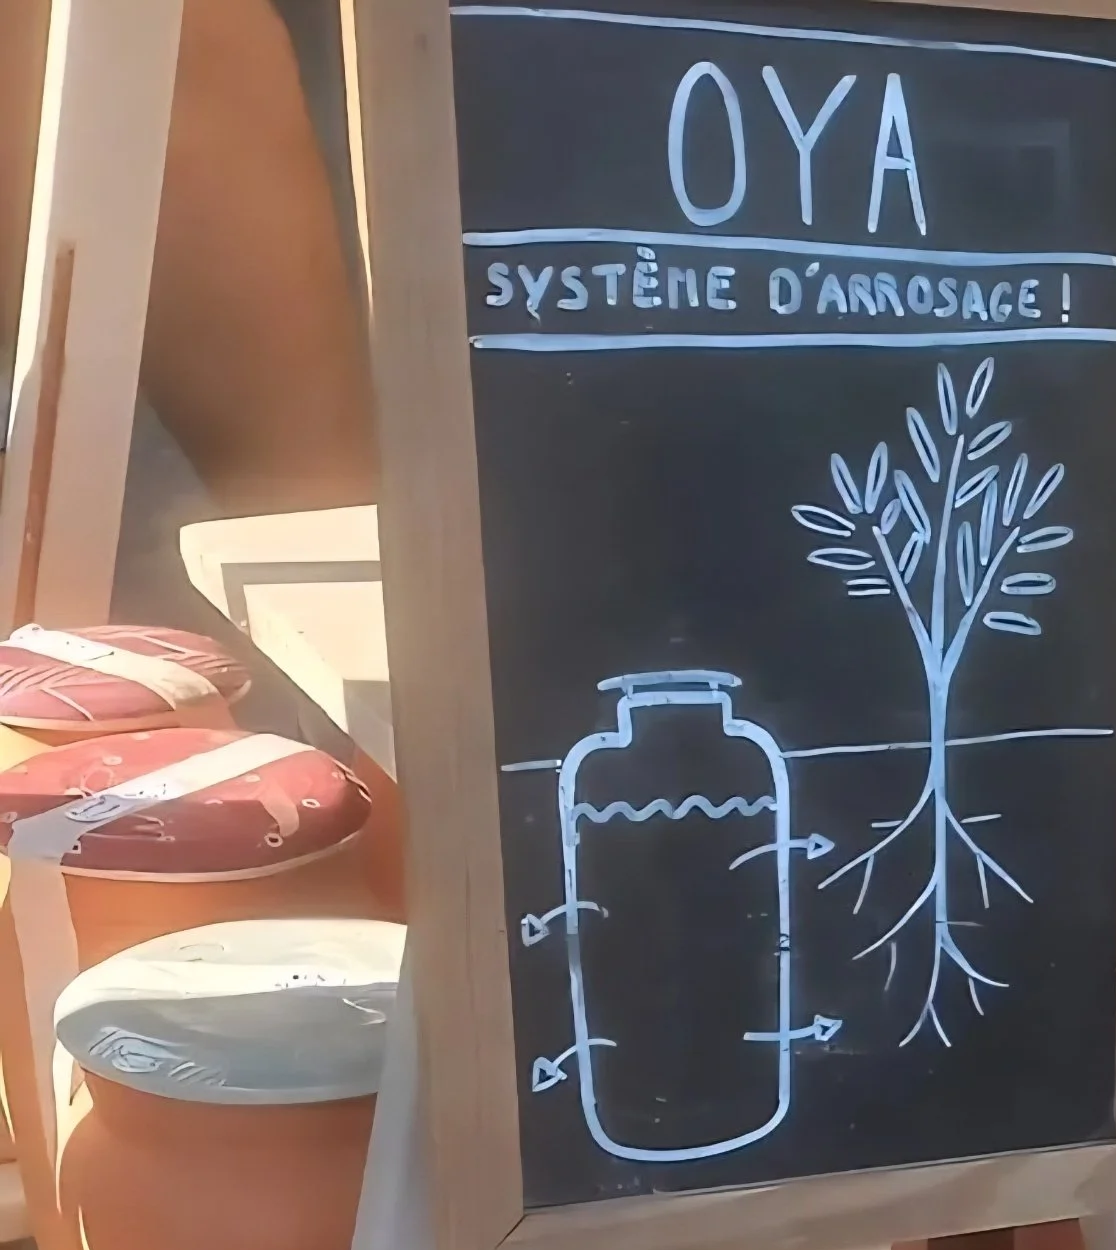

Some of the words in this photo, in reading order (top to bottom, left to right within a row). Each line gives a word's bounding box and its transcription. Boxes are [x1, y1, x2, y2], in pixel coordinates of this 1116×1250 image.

[667, 60, 927, 236] OYA
[769, 262, 1042, 323] D'ARROSAGE
[1060, 272, 1072, 323] !
